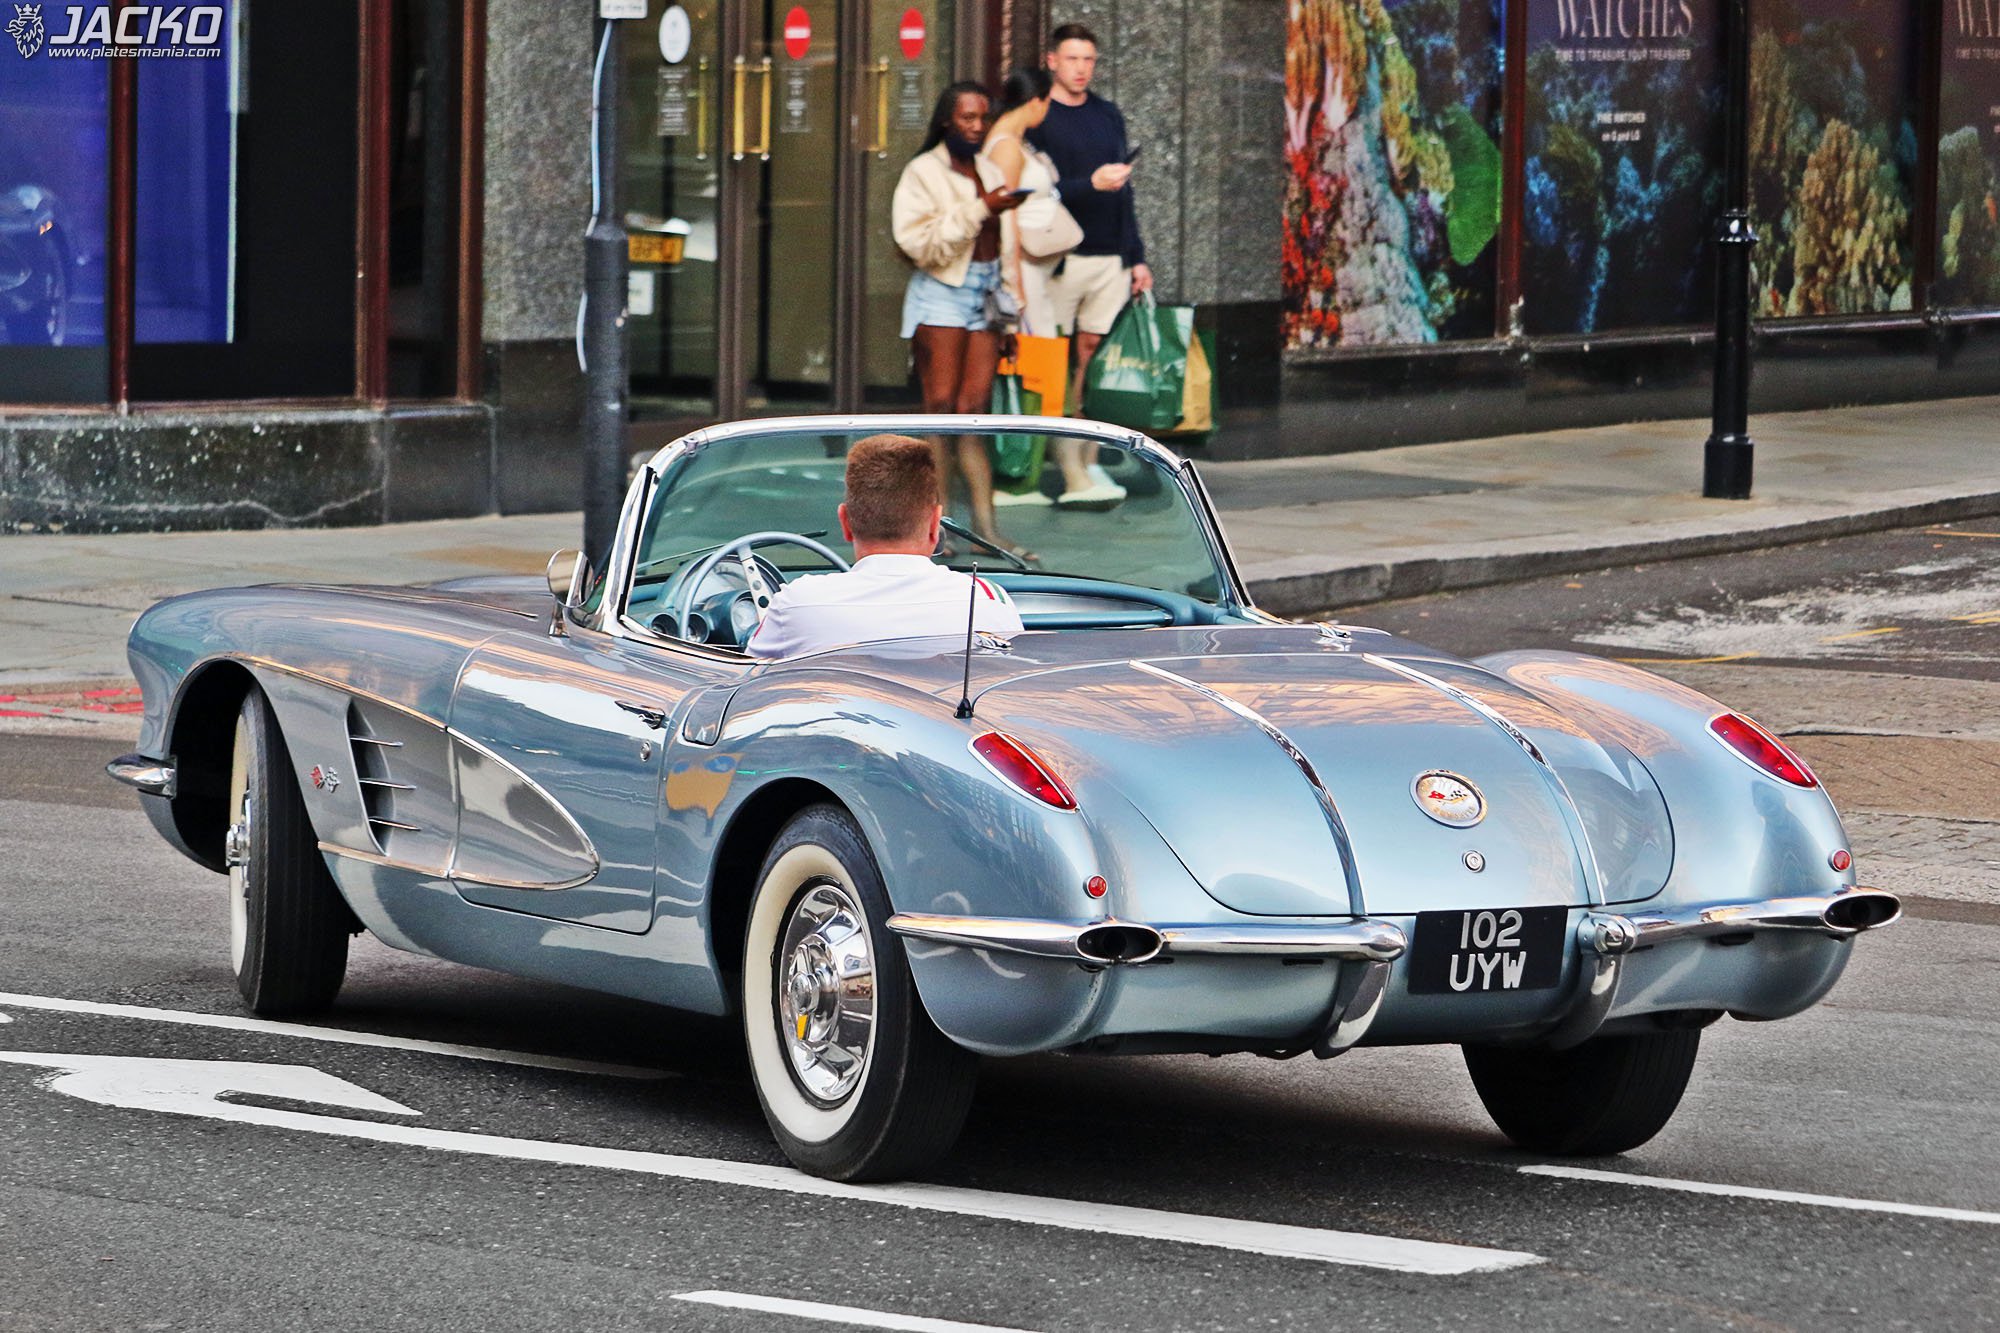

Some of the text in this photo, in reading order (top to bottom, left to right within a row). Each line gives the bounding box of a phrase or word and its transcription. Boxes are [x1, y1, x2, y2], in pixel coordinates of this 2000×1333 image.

[1557, 0, 1693, 38] WATCHES
[1575, 49, 1585, 61] TO
[1460, 909, 1523, 949] 102
[1449, 951, 1526, 992] UYW
